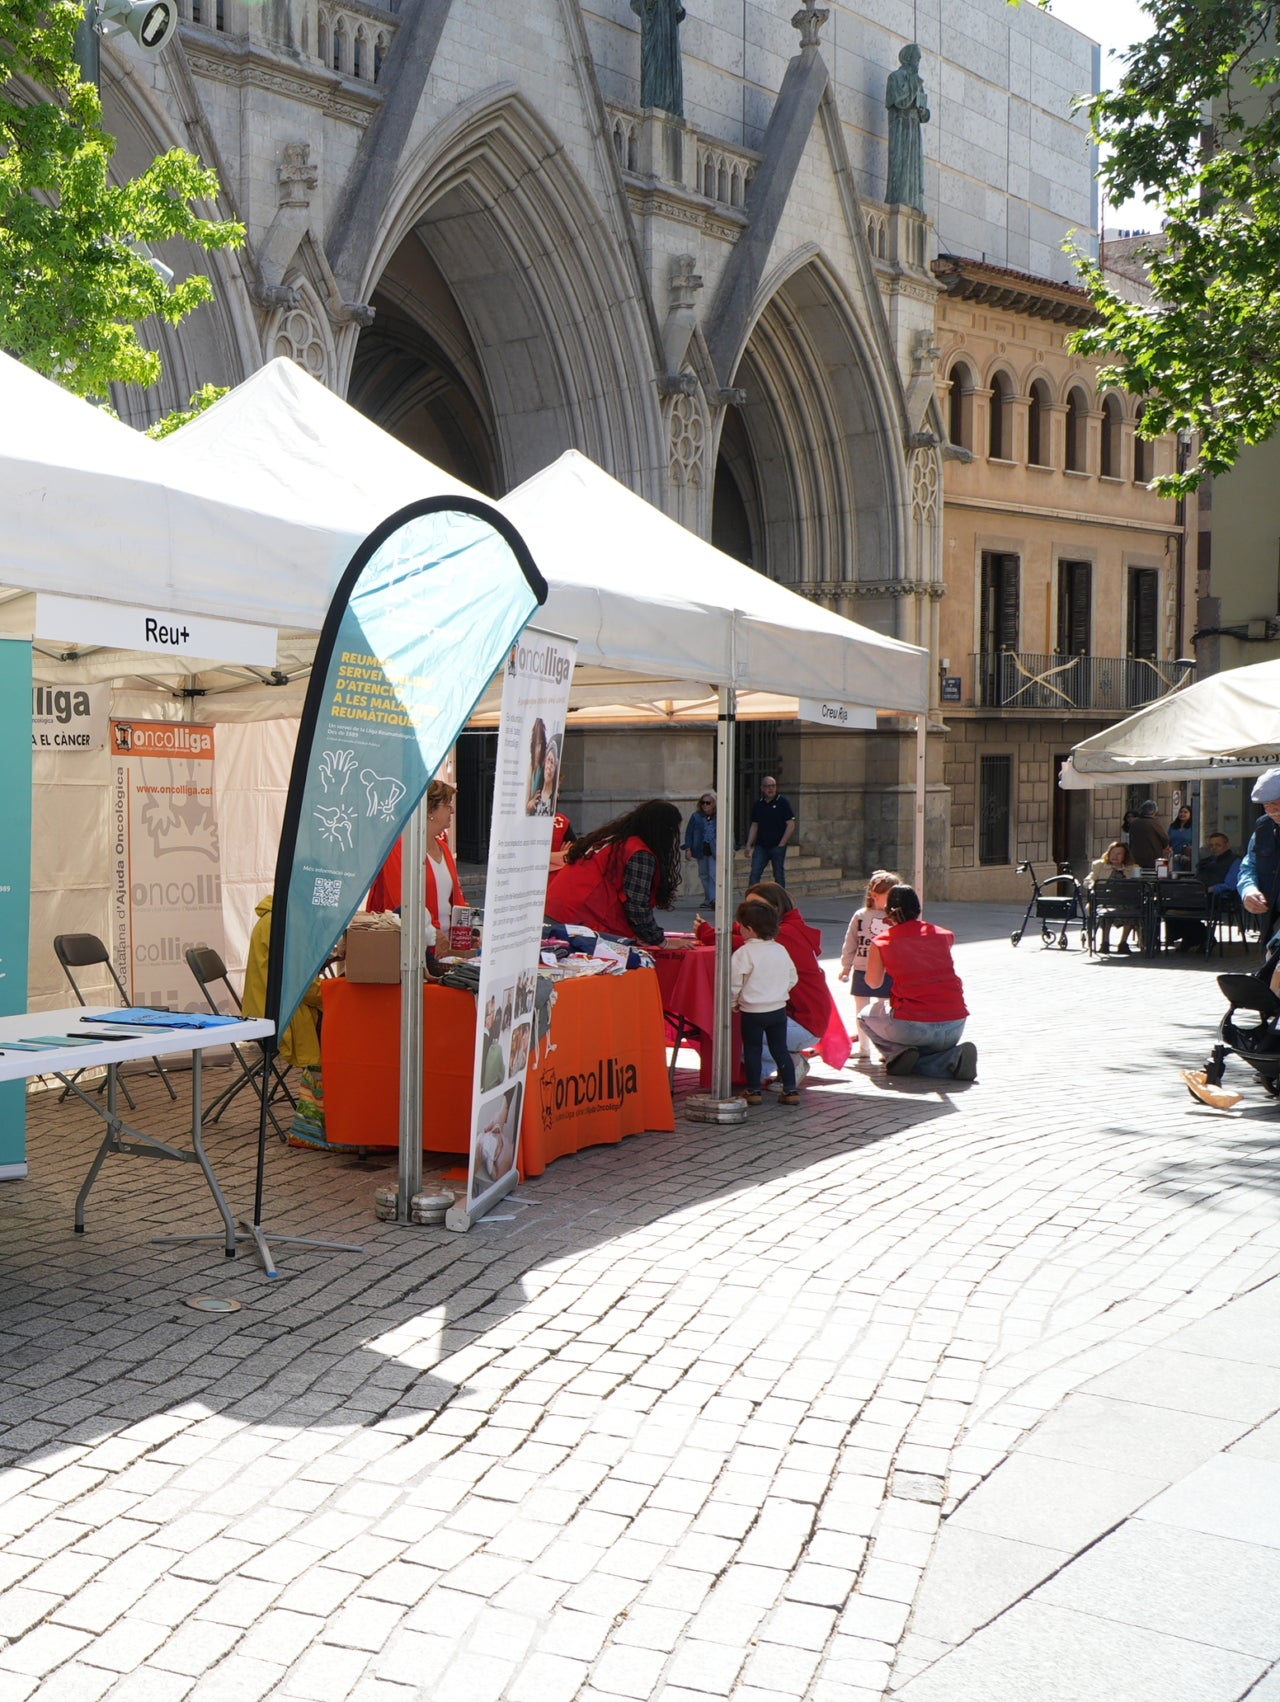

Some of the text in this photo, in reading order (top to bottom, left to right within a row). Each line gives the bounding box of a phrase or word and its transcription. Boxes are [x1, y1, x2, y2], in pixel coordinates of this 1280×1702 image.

[145, 617, 190, 646] Reu+
[338, 665, 383, 682] SERVEI
[519, 646, 570, 685] oncolliga
[333, 692, 342, 703] A
[346, 694, 368, 707] LES
[822, 704, 838, 719] Creu
[40, 734, 51, 746] EL
[54, 731, 91, 746] CÀNCER
[133, 728, 211, 753] oncolliga
[115, 767, 124, 854] Oncològica
